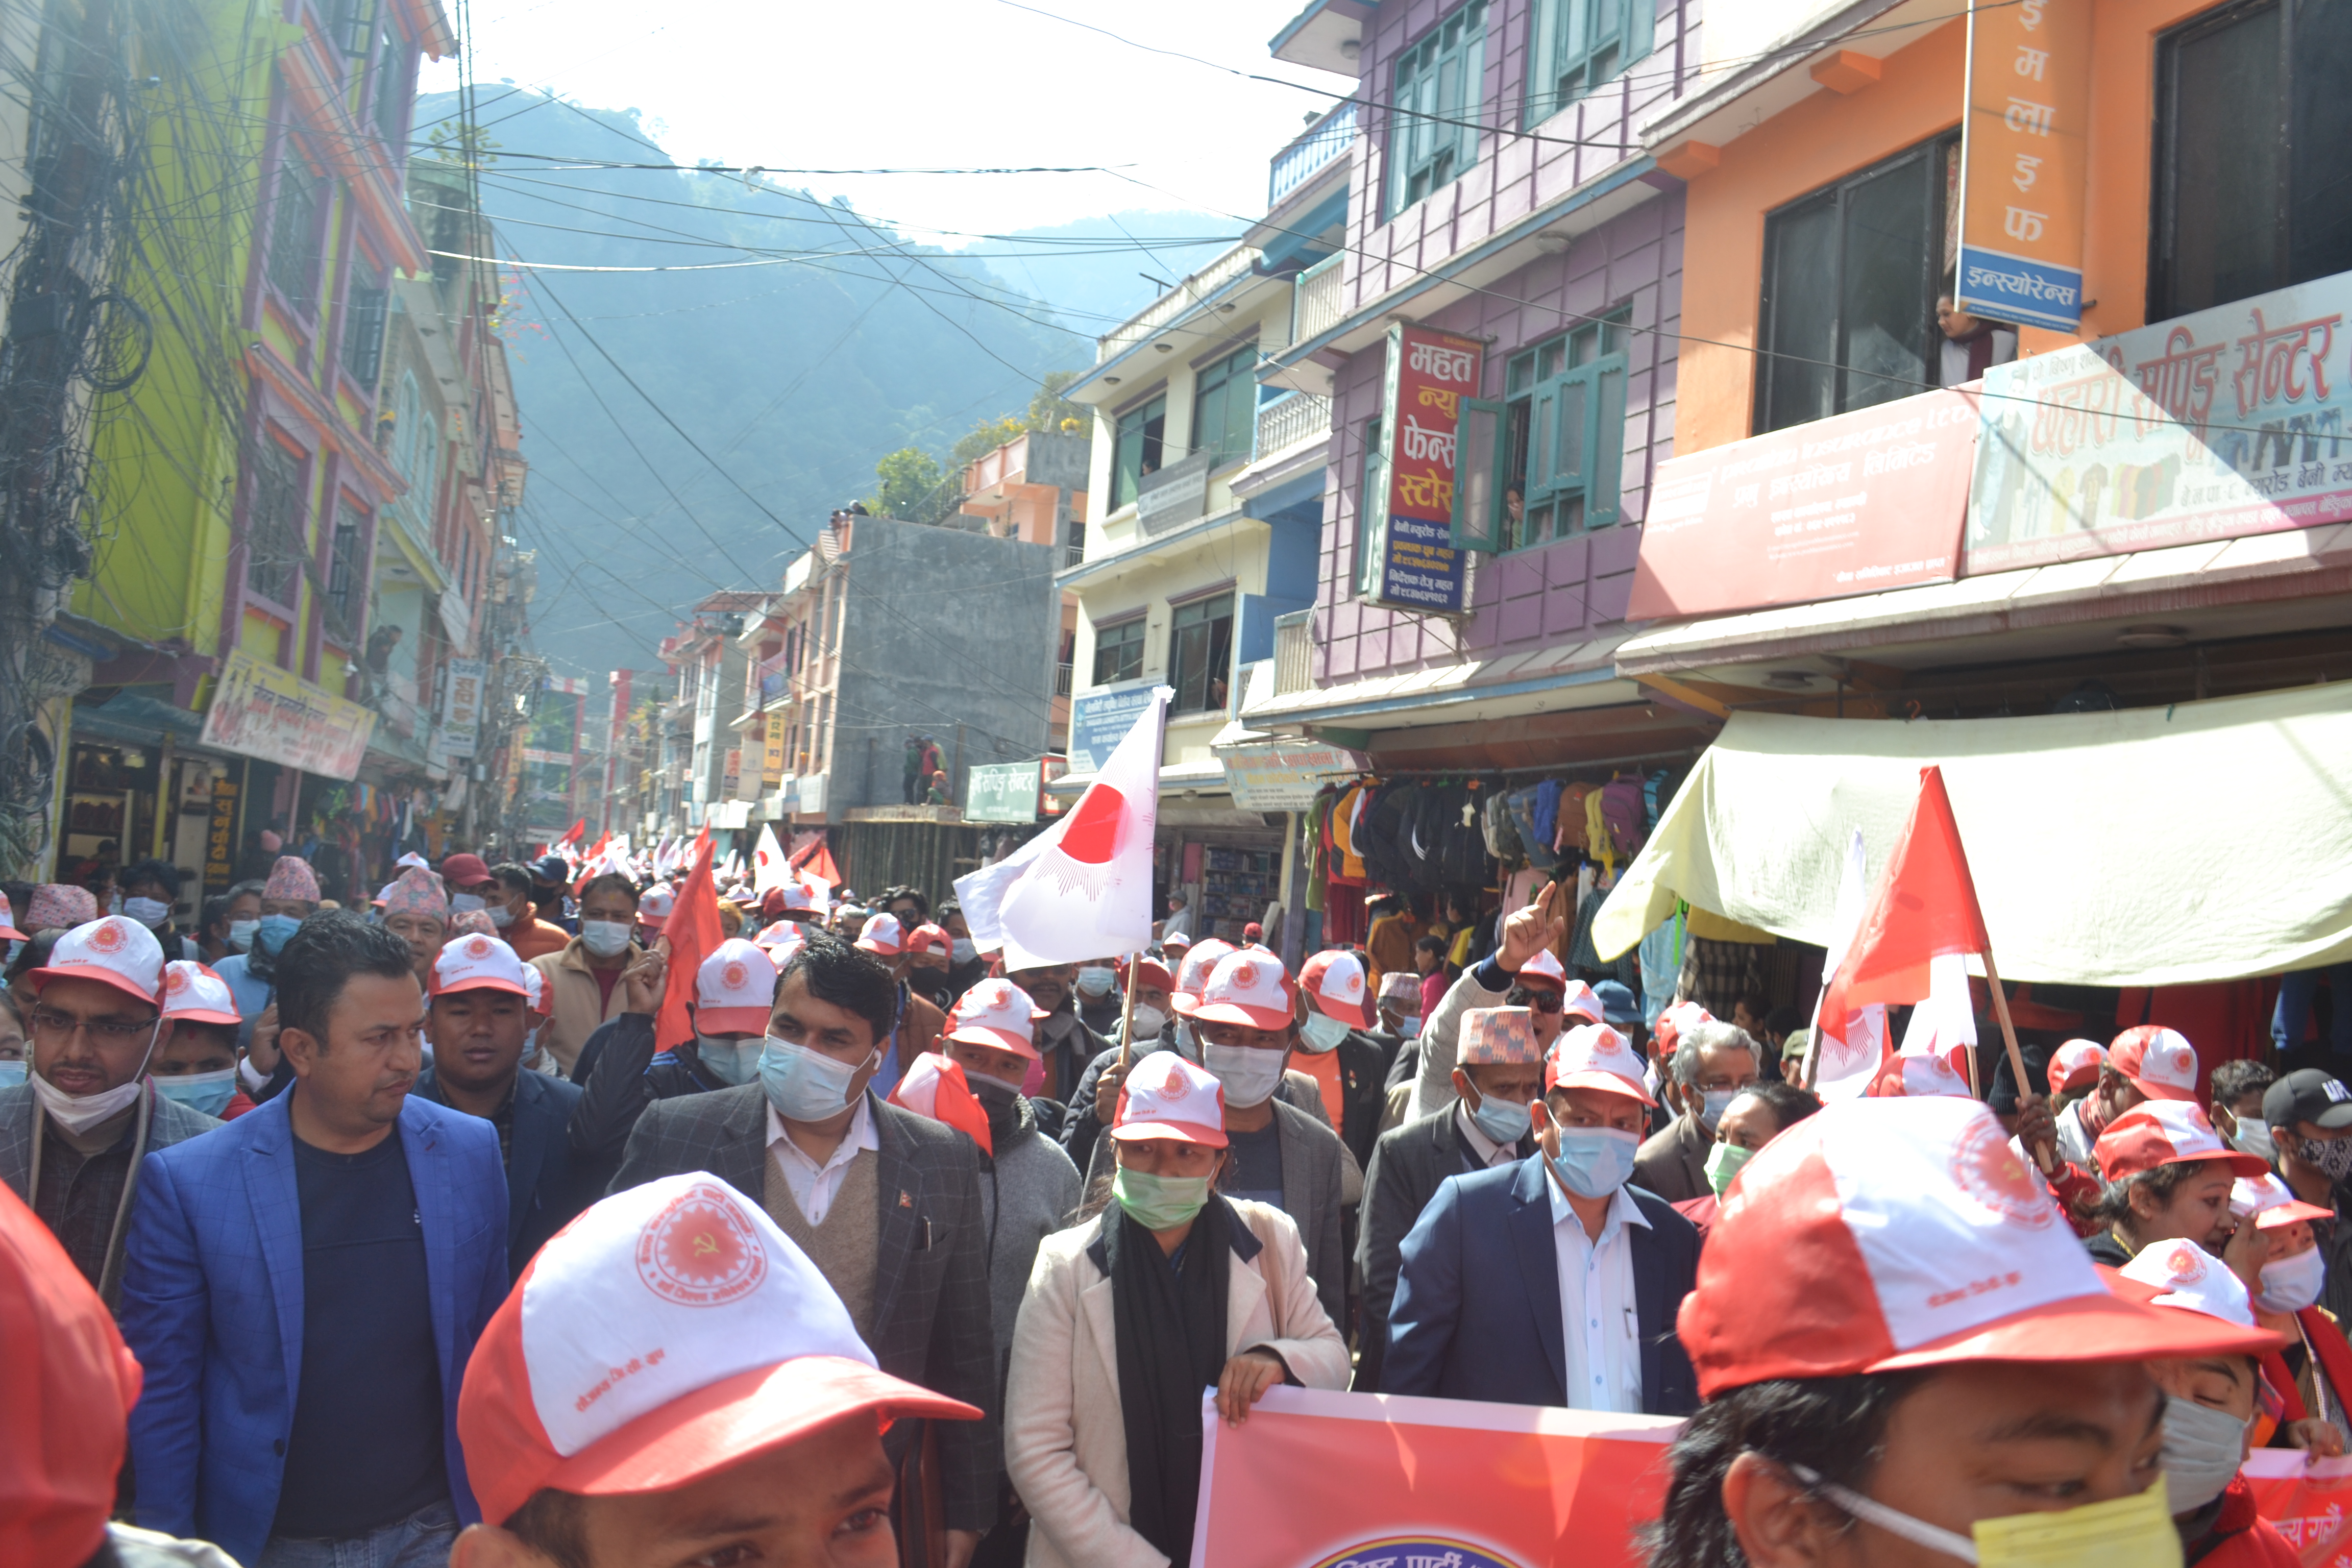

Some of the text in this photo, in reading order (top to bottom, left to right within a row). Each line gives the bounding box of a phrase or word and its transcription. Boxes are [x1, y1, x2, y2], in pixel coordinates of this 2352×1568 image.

[1967, 265, 2077, 306] इन्स्योरेन्स
[1409, 341, 1474, 382] महत
[2233, 307, 2342, 419] सेन्टर
[1418, 385, 1459, 419] न्यु
[1863, 441, 1938, 477] लिमिटेड
